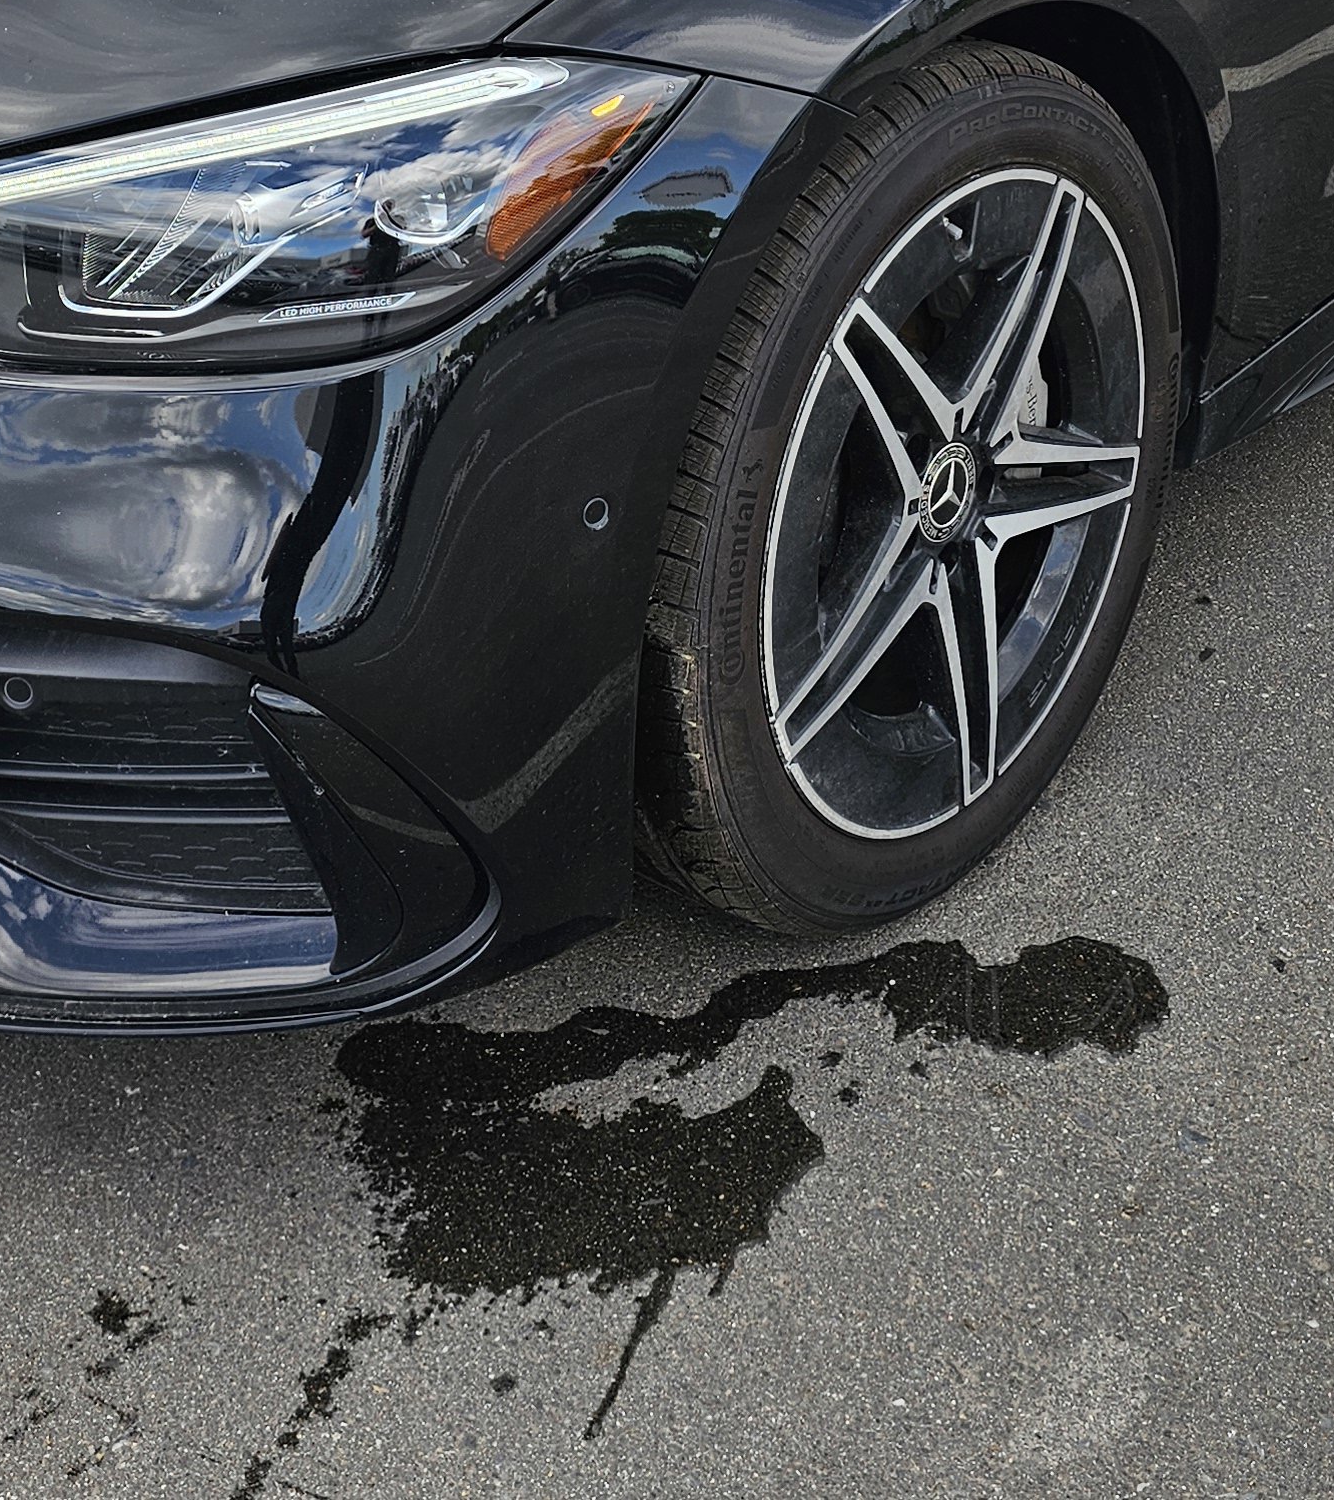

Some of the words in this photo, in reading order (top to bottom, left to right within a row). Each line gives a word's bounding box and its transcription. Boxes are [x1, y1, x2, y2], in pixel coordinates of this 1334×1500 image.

[279, 308, 298, 318] LED
[299, 305, 324, 316] HIGH
[324, 297, 393, 313] PERFORMANCE
[719, 489, 759, 687] Continental
